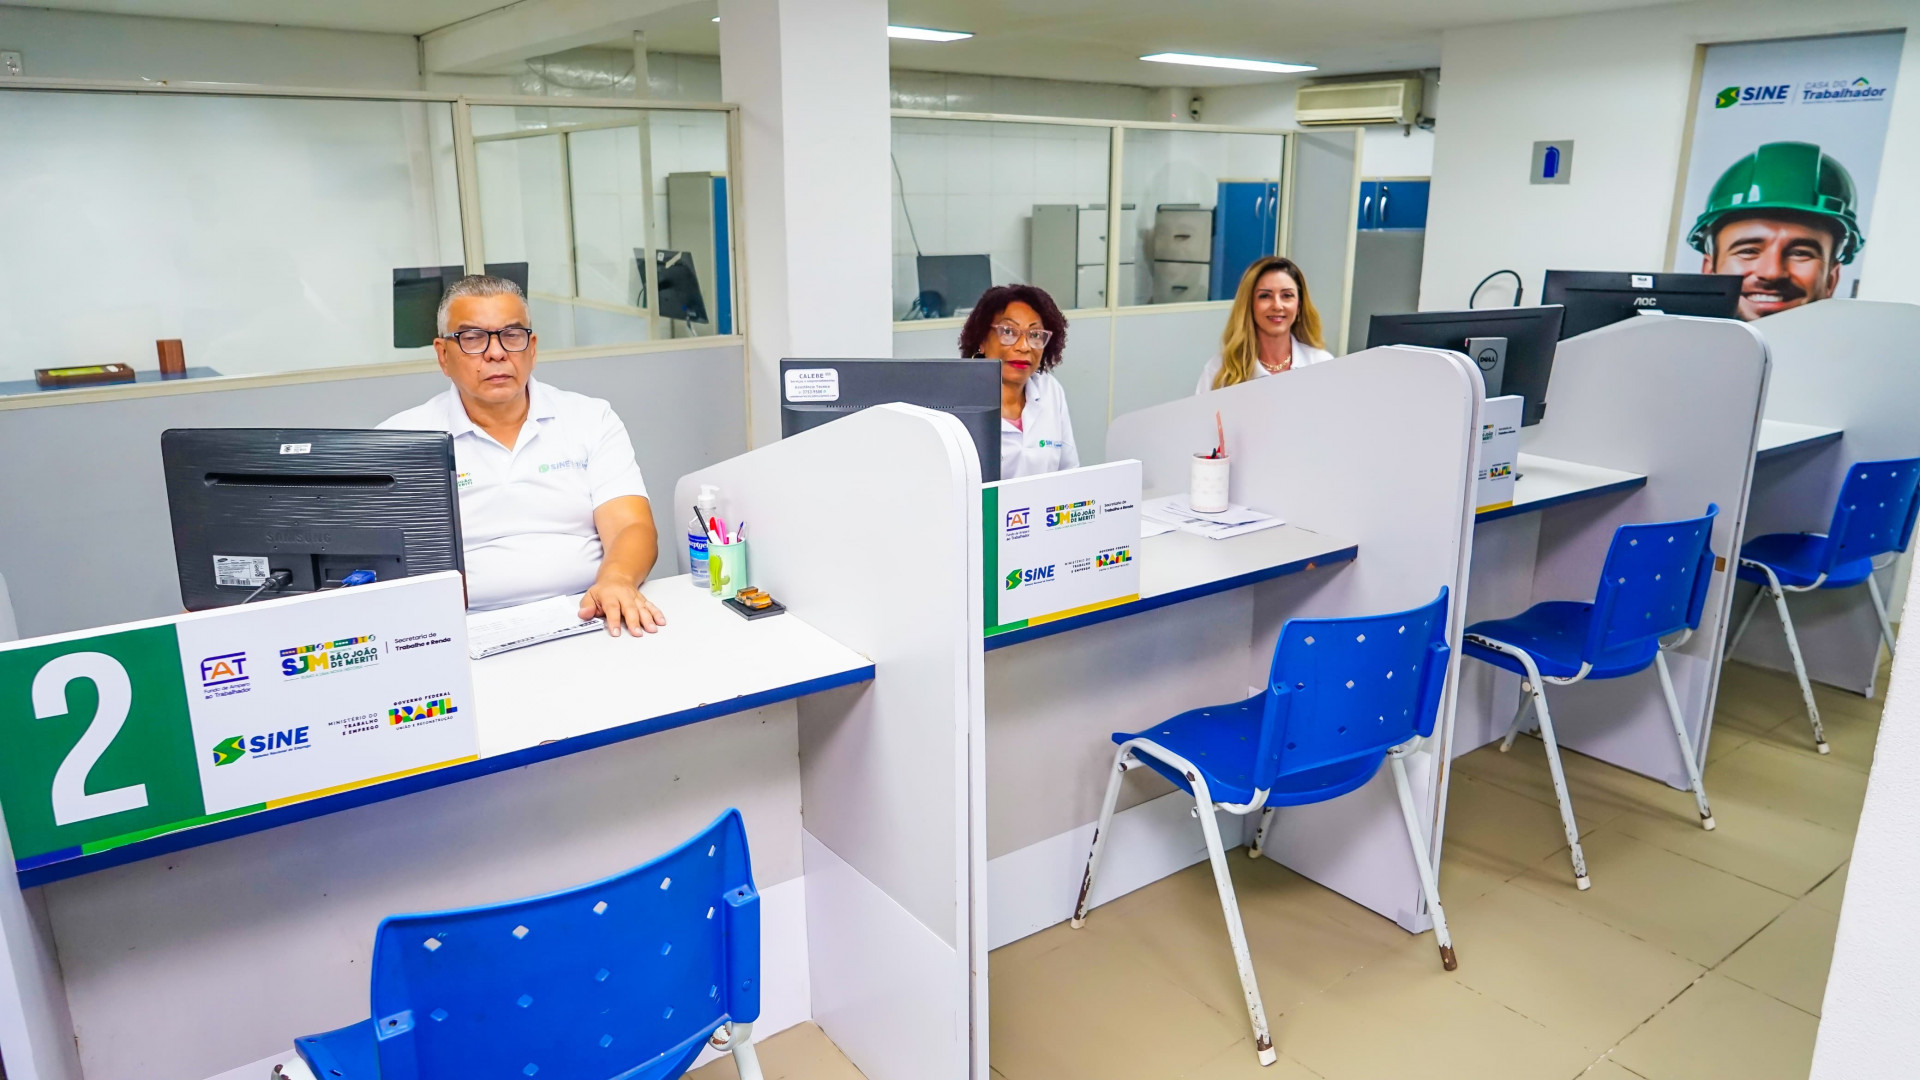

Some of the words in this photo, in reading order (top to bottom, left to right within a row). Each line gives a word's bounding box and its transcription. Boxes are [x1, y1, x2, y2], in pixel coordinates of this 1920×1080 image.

[1805, 81, 1829, 89] CASA
[1833, 80, 1847, 88] DO
[1804, 87, 1886, 100] Trabalhador
[1634, 297, 1657, 306] AOC
[1006, 507, 1030, 527] FAT
[1046, 511, 1071, 527] SJM
[1095, 549, 1132, 568] BRASIL
[395, 634, 427, 643] Secretaria
[395, 642, 425, 651] Trabalho
[431, 637, 451, 645] Renda
[330, 652, 350, 662] SÃO
[351, 647, 377, 657] JOÃO
[345, 654, 378, 666] MERITI
[201, 651, 247, 681] FAT
[281, 652, 329, 676] SJM
[393, 697, 423, 706] GOVERNO
[425, 691, 451, 700] FEDERAL
[388, 697, 458, 726] BRASIL
[328, 714, 367, 726] MINISTÉRIO
[344, 719, 379, 729] TRABALHO
[349, 725, 379, 735] EMPREGO
[31, 651, 149, 827] 2
